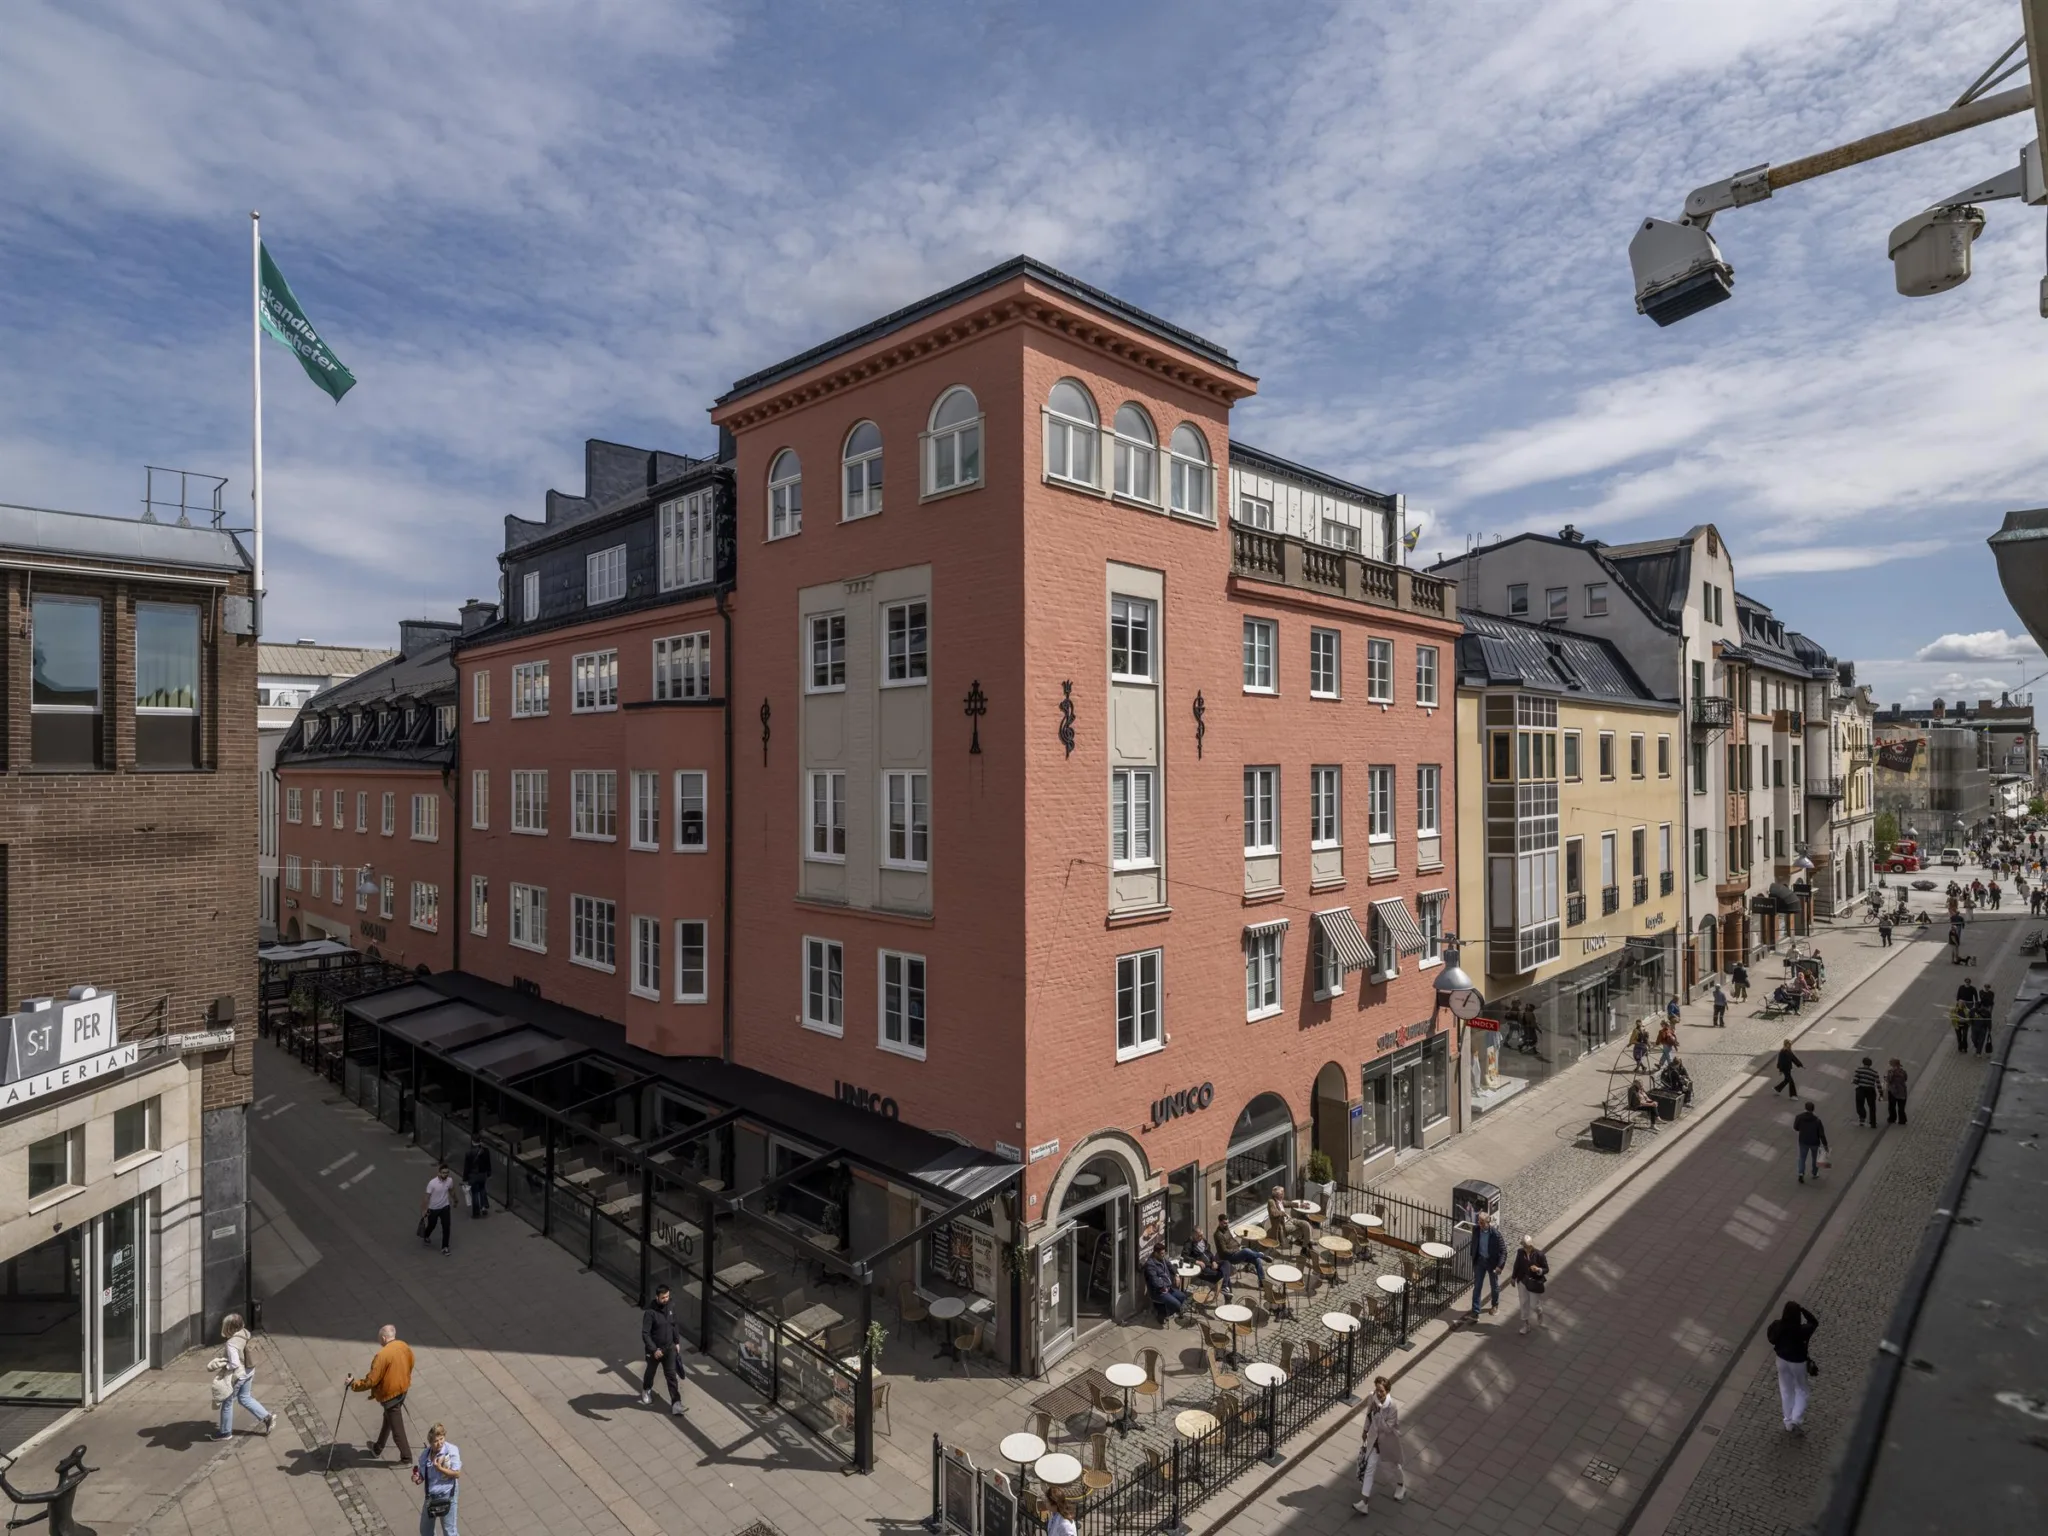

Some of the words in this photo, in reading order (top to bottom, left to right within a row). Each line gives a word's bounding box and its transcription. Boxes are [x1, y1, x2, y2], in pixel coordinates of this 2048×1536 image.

[74, 1012, 101, 1044] PER
[1467, 1020, 1495, 1029] LINDEX
[1151, 1081, 1214, 1126] UNICO
[657, 1218, 693, 1257] UNICO
